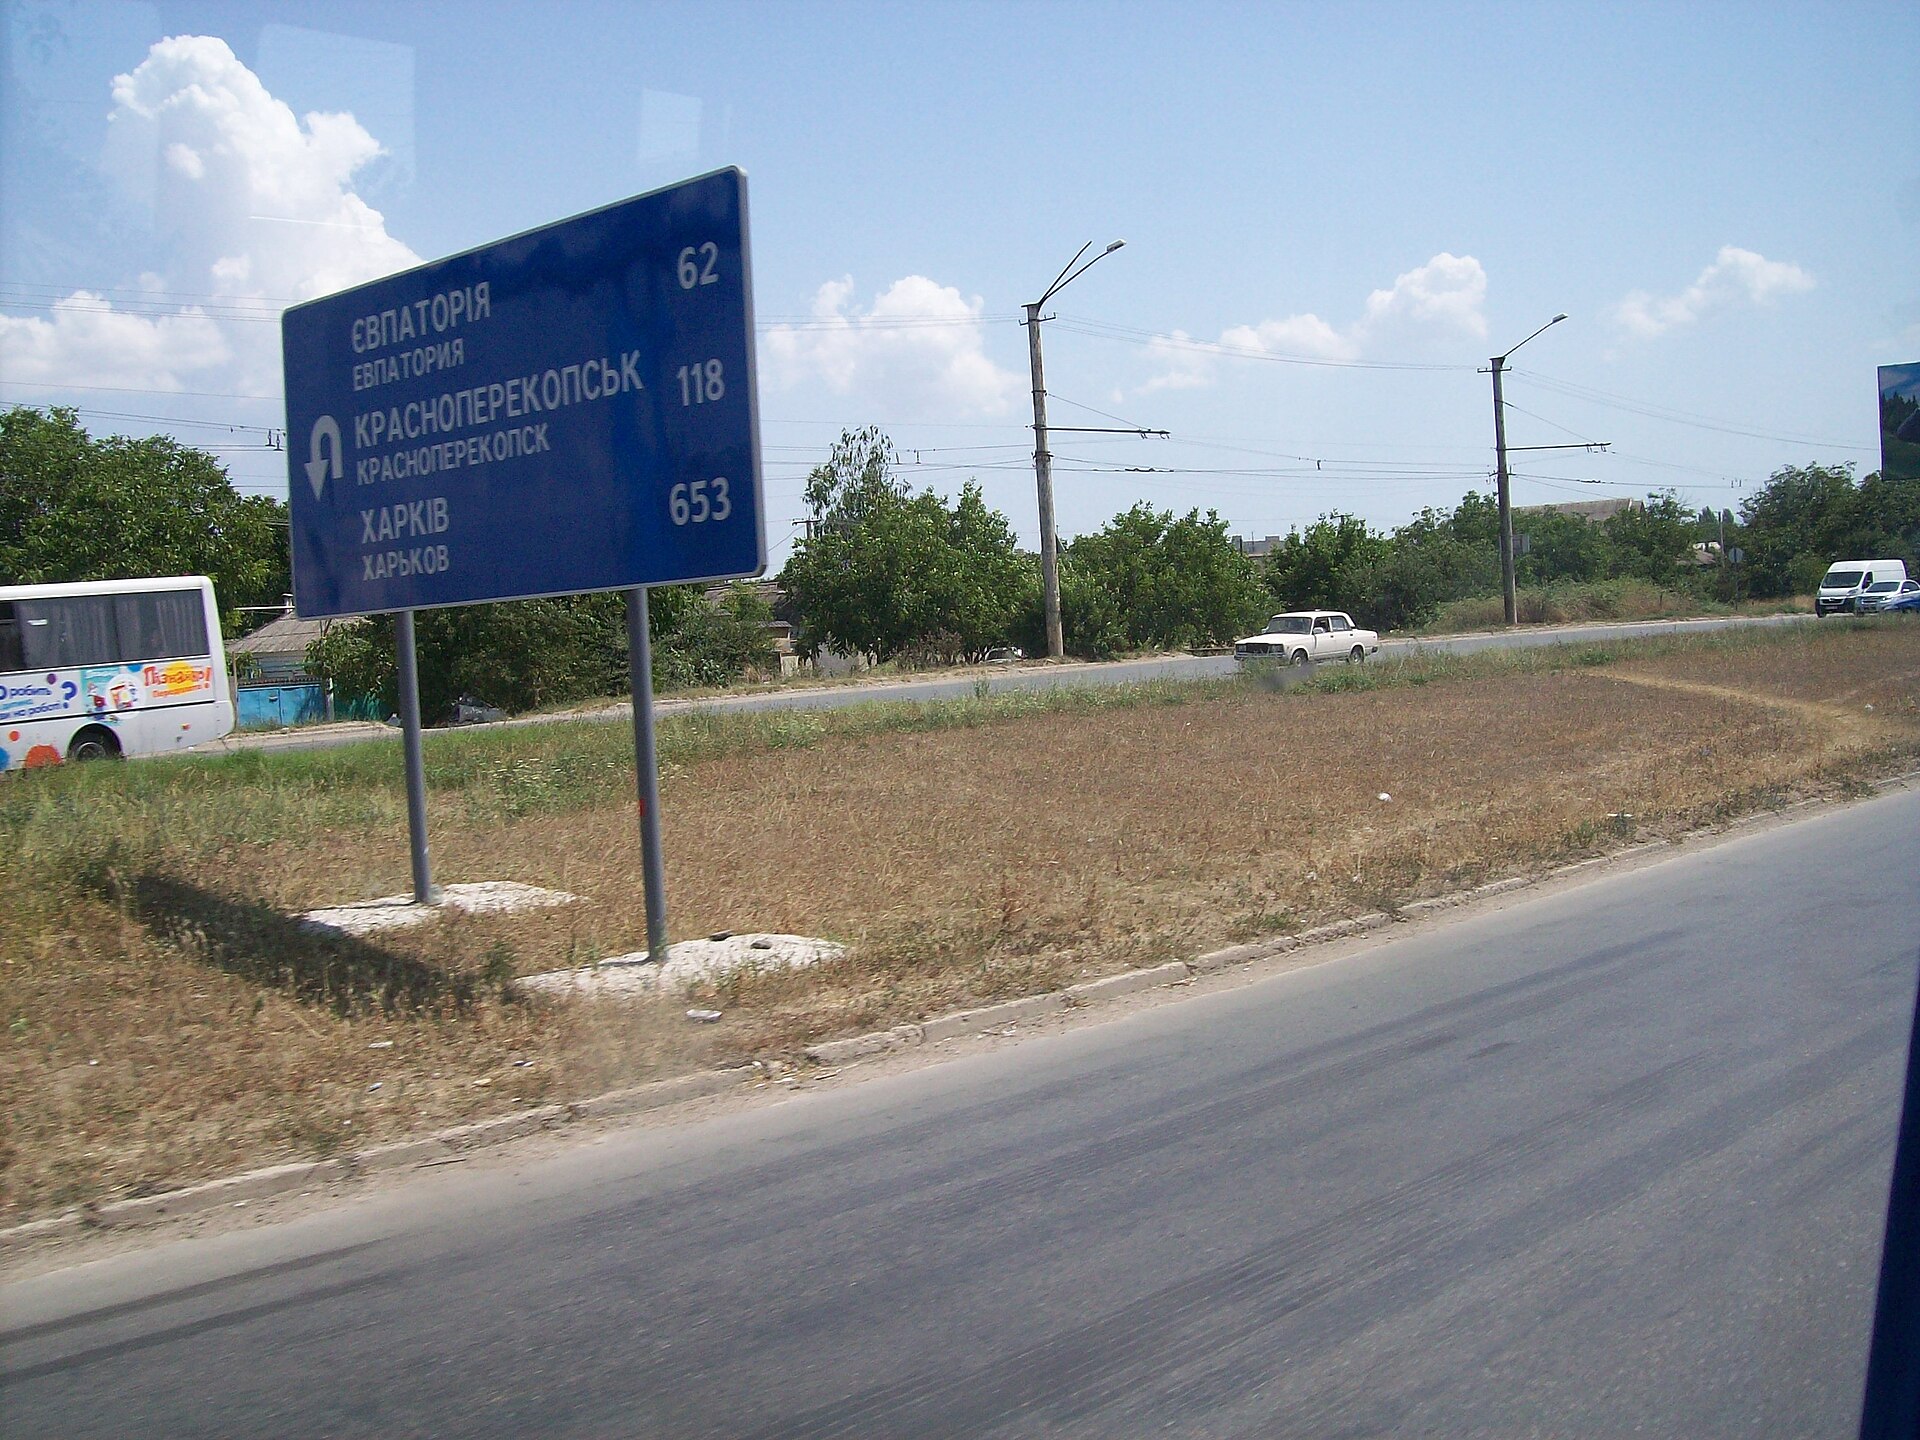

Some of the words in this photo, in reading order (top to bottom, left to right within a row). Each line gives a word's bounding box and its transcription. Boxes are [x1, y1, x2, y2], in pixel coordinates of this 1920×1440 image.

[678, 241, 719, 290] 62
[352, 281, 491, 354] ЄВПАТОРІЯ
[353, 338, 465, 392] ЕВПАТОРИЯ
[676, 358, 726, 406] 118
[354, 349, 644, 449] КРАСНОПЕРЕКОПСЬК
[356, 422, 550, 486] КРАСНОПЕРЕКОПСК
[360, 497, 450, 544] ХАРКІВ
[669, 476, 732, 526] 653
[362, 544, 450, 580] ХАРЬКОВ
